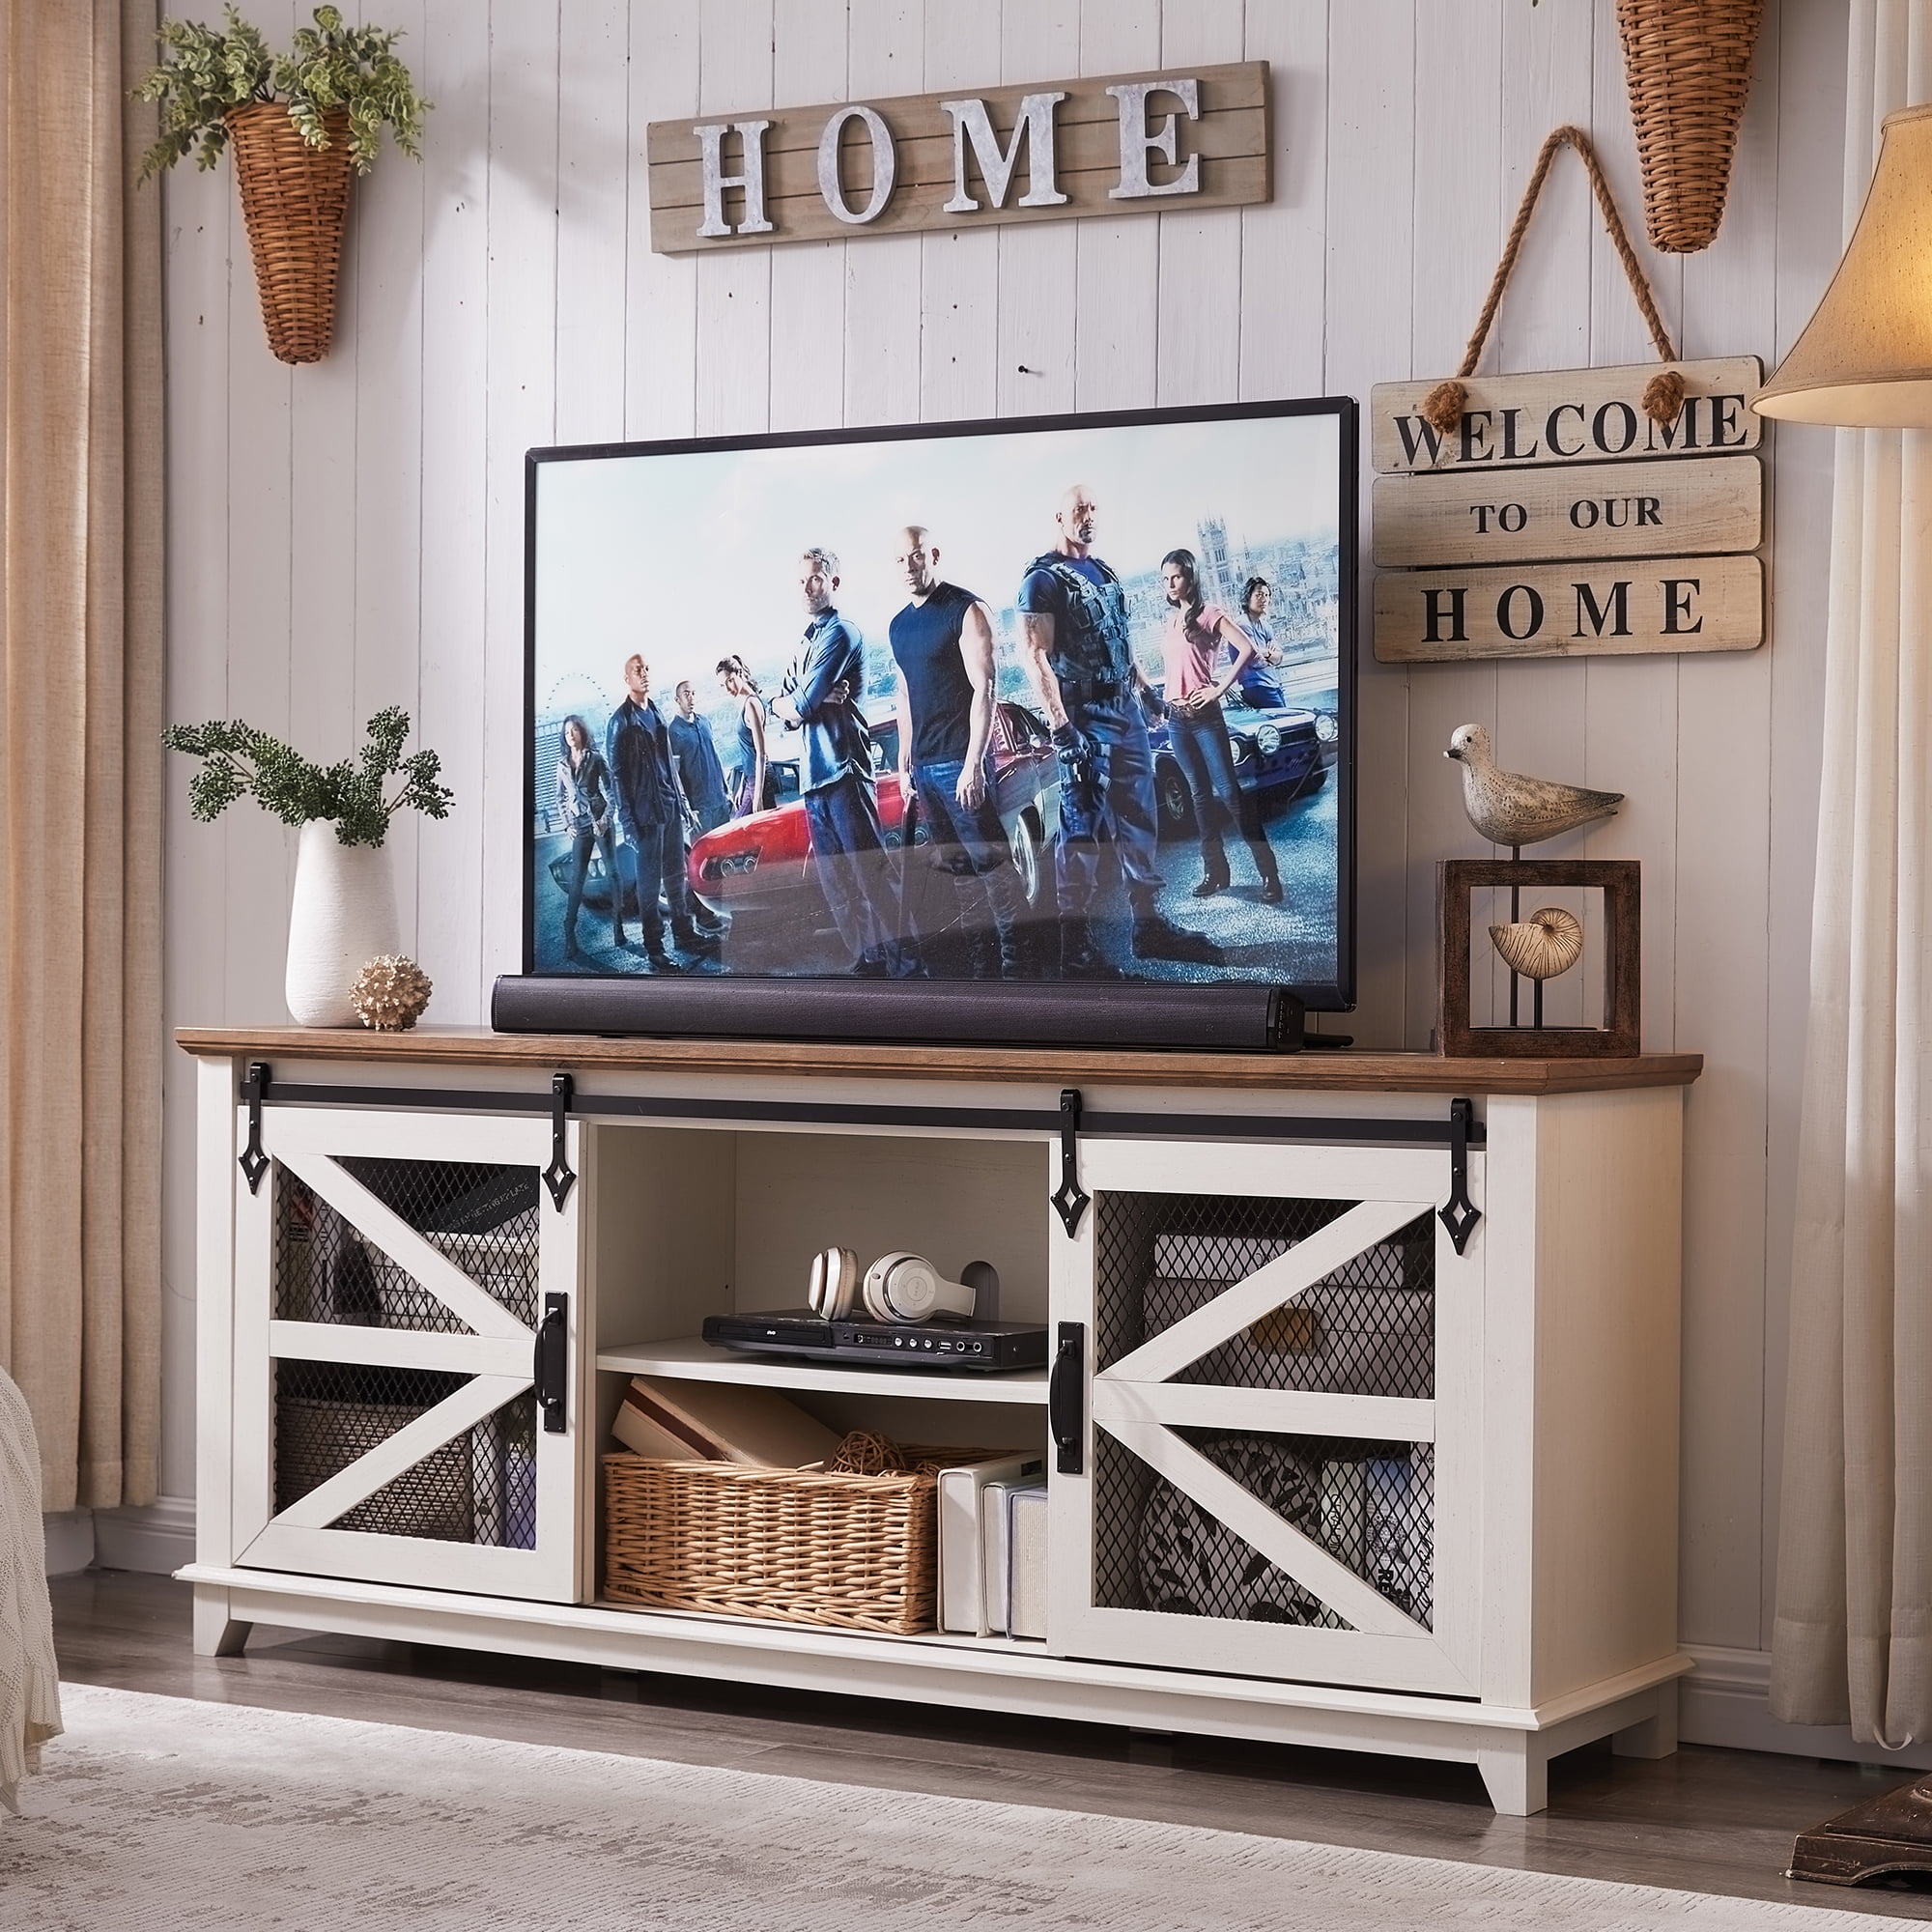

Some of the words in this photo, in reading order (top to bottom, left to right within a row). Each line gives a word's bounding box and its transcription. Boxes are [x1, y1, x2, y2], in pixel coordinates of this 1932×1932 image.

[694, 78, 1204, 238] HOME
[1392, 394, 1748, 466] WELCOME
[1469, 503, 1528, 534] TO
[1569, 497, 1663, 529] OUR
[1420, 578, 1703, 643] HOME
